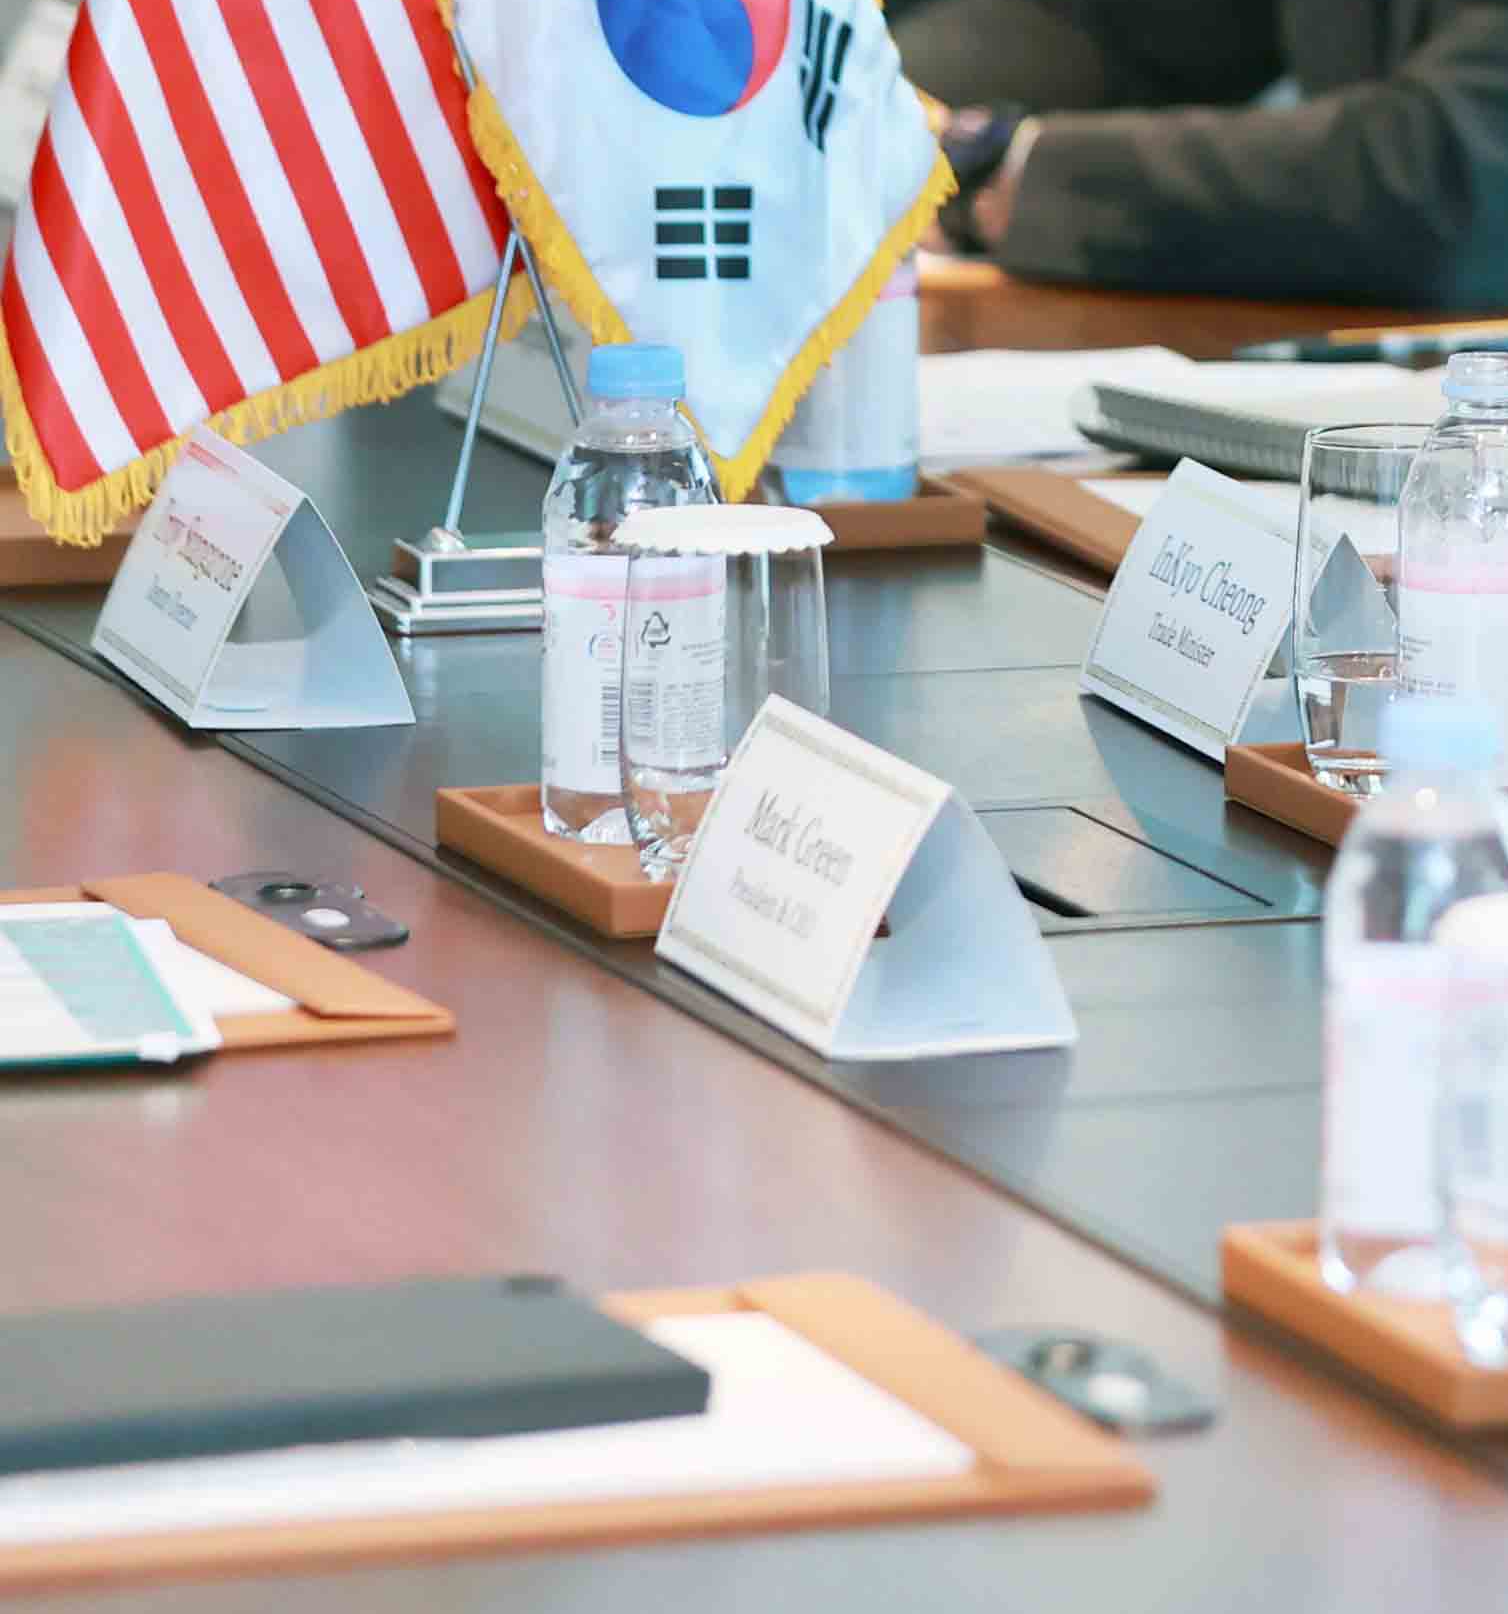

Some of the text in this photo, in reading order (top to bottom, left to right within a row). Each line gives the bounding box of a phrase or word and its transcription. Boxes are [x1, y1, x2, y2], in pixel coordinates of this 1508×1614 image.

[1149, 534, 1268, 635] InKyo Cheong
[743, 789, 855, 886] Mark Green
